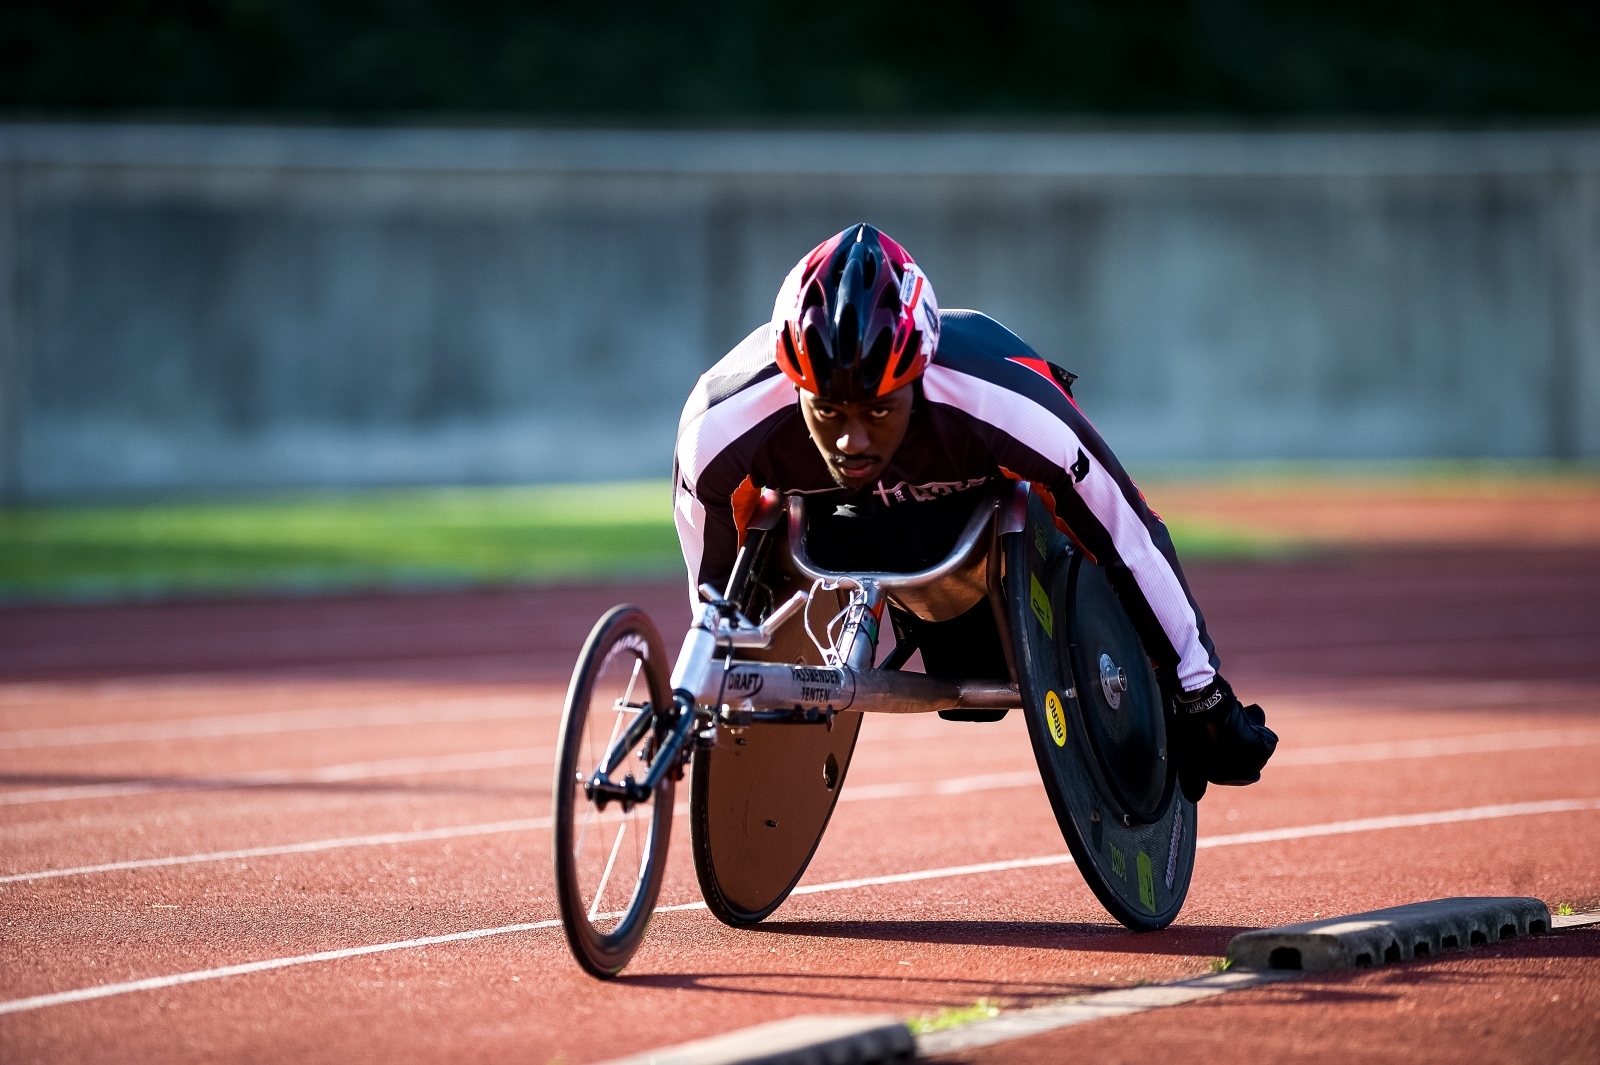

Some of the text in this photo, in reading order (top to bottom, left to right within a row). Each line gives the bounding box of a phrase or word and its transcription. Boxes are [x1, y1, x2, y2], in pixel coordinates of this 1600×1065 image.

[728, 673, 759, 690] DRAFT
[801, 687, 830, 703] TENTEN
[1049, 698, 1064, 739] ARAG
